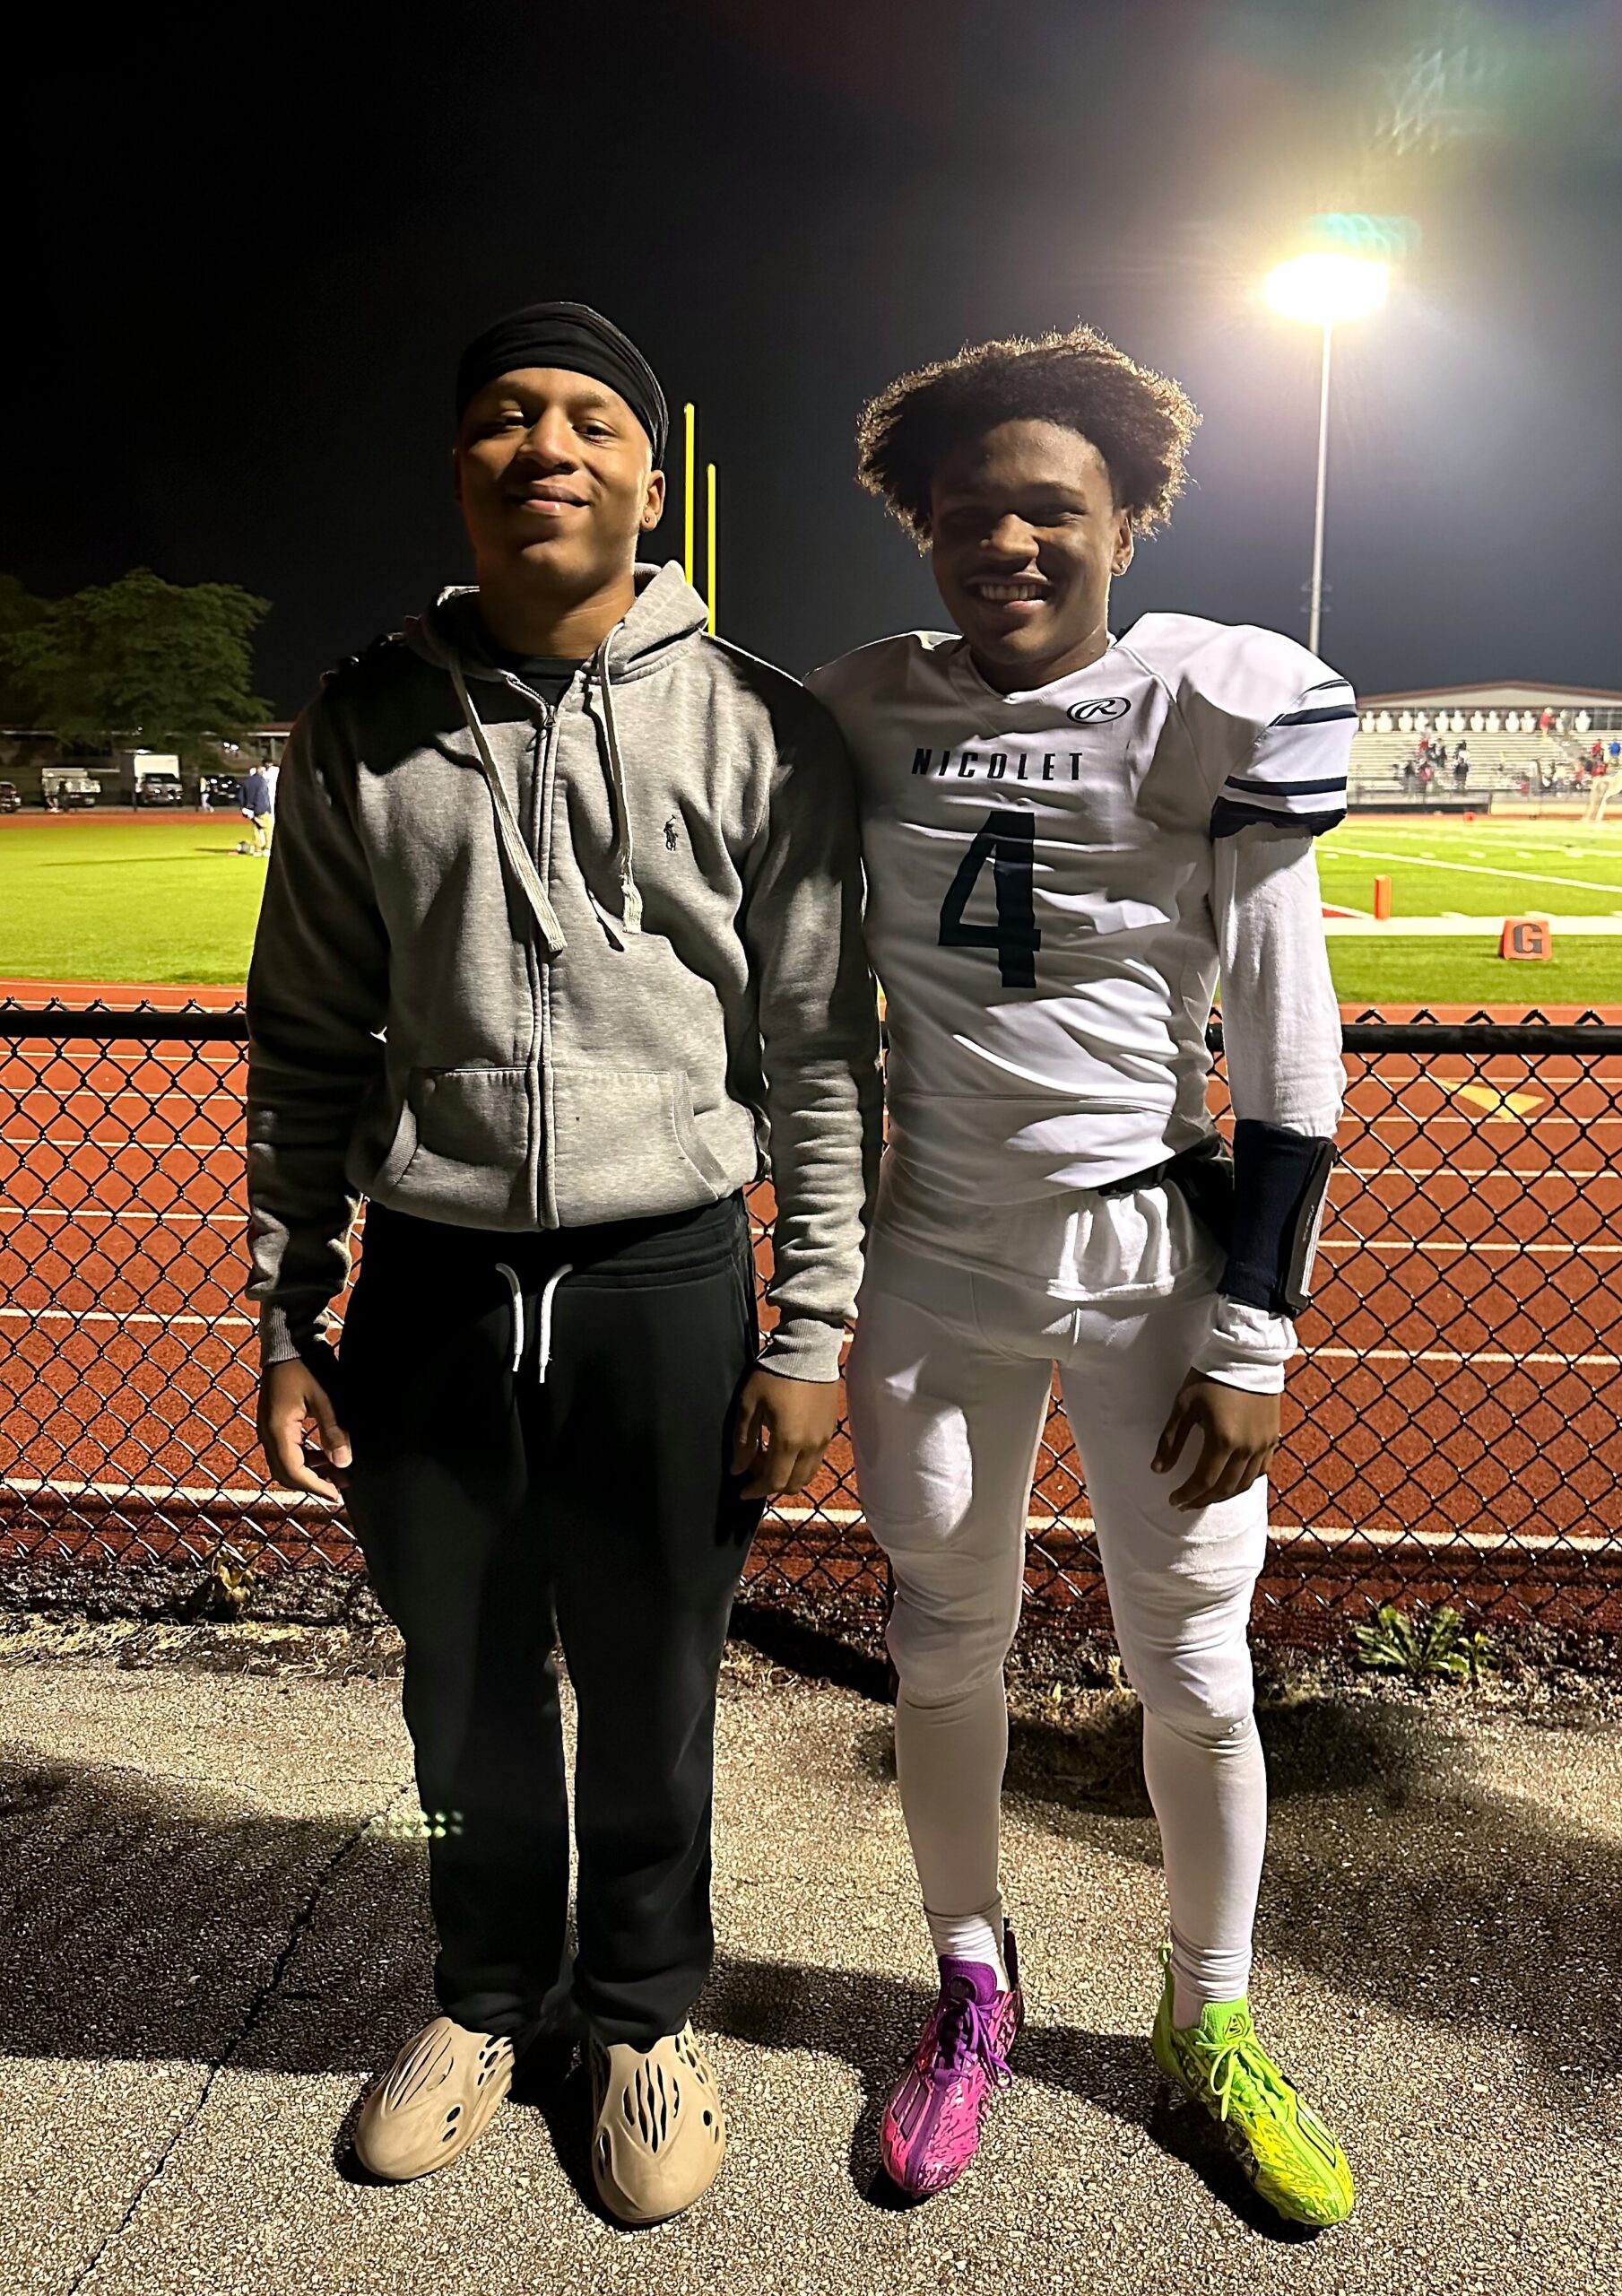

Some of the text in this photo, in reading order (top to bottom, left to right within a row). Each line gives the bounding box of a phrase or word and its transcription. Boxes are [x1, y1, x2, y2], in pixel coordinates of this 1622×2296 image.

[911, 748, 1083, 781] NICOLET
[938, 811, 1042, 987] 4
[1513, 923, 1543, 954] G
